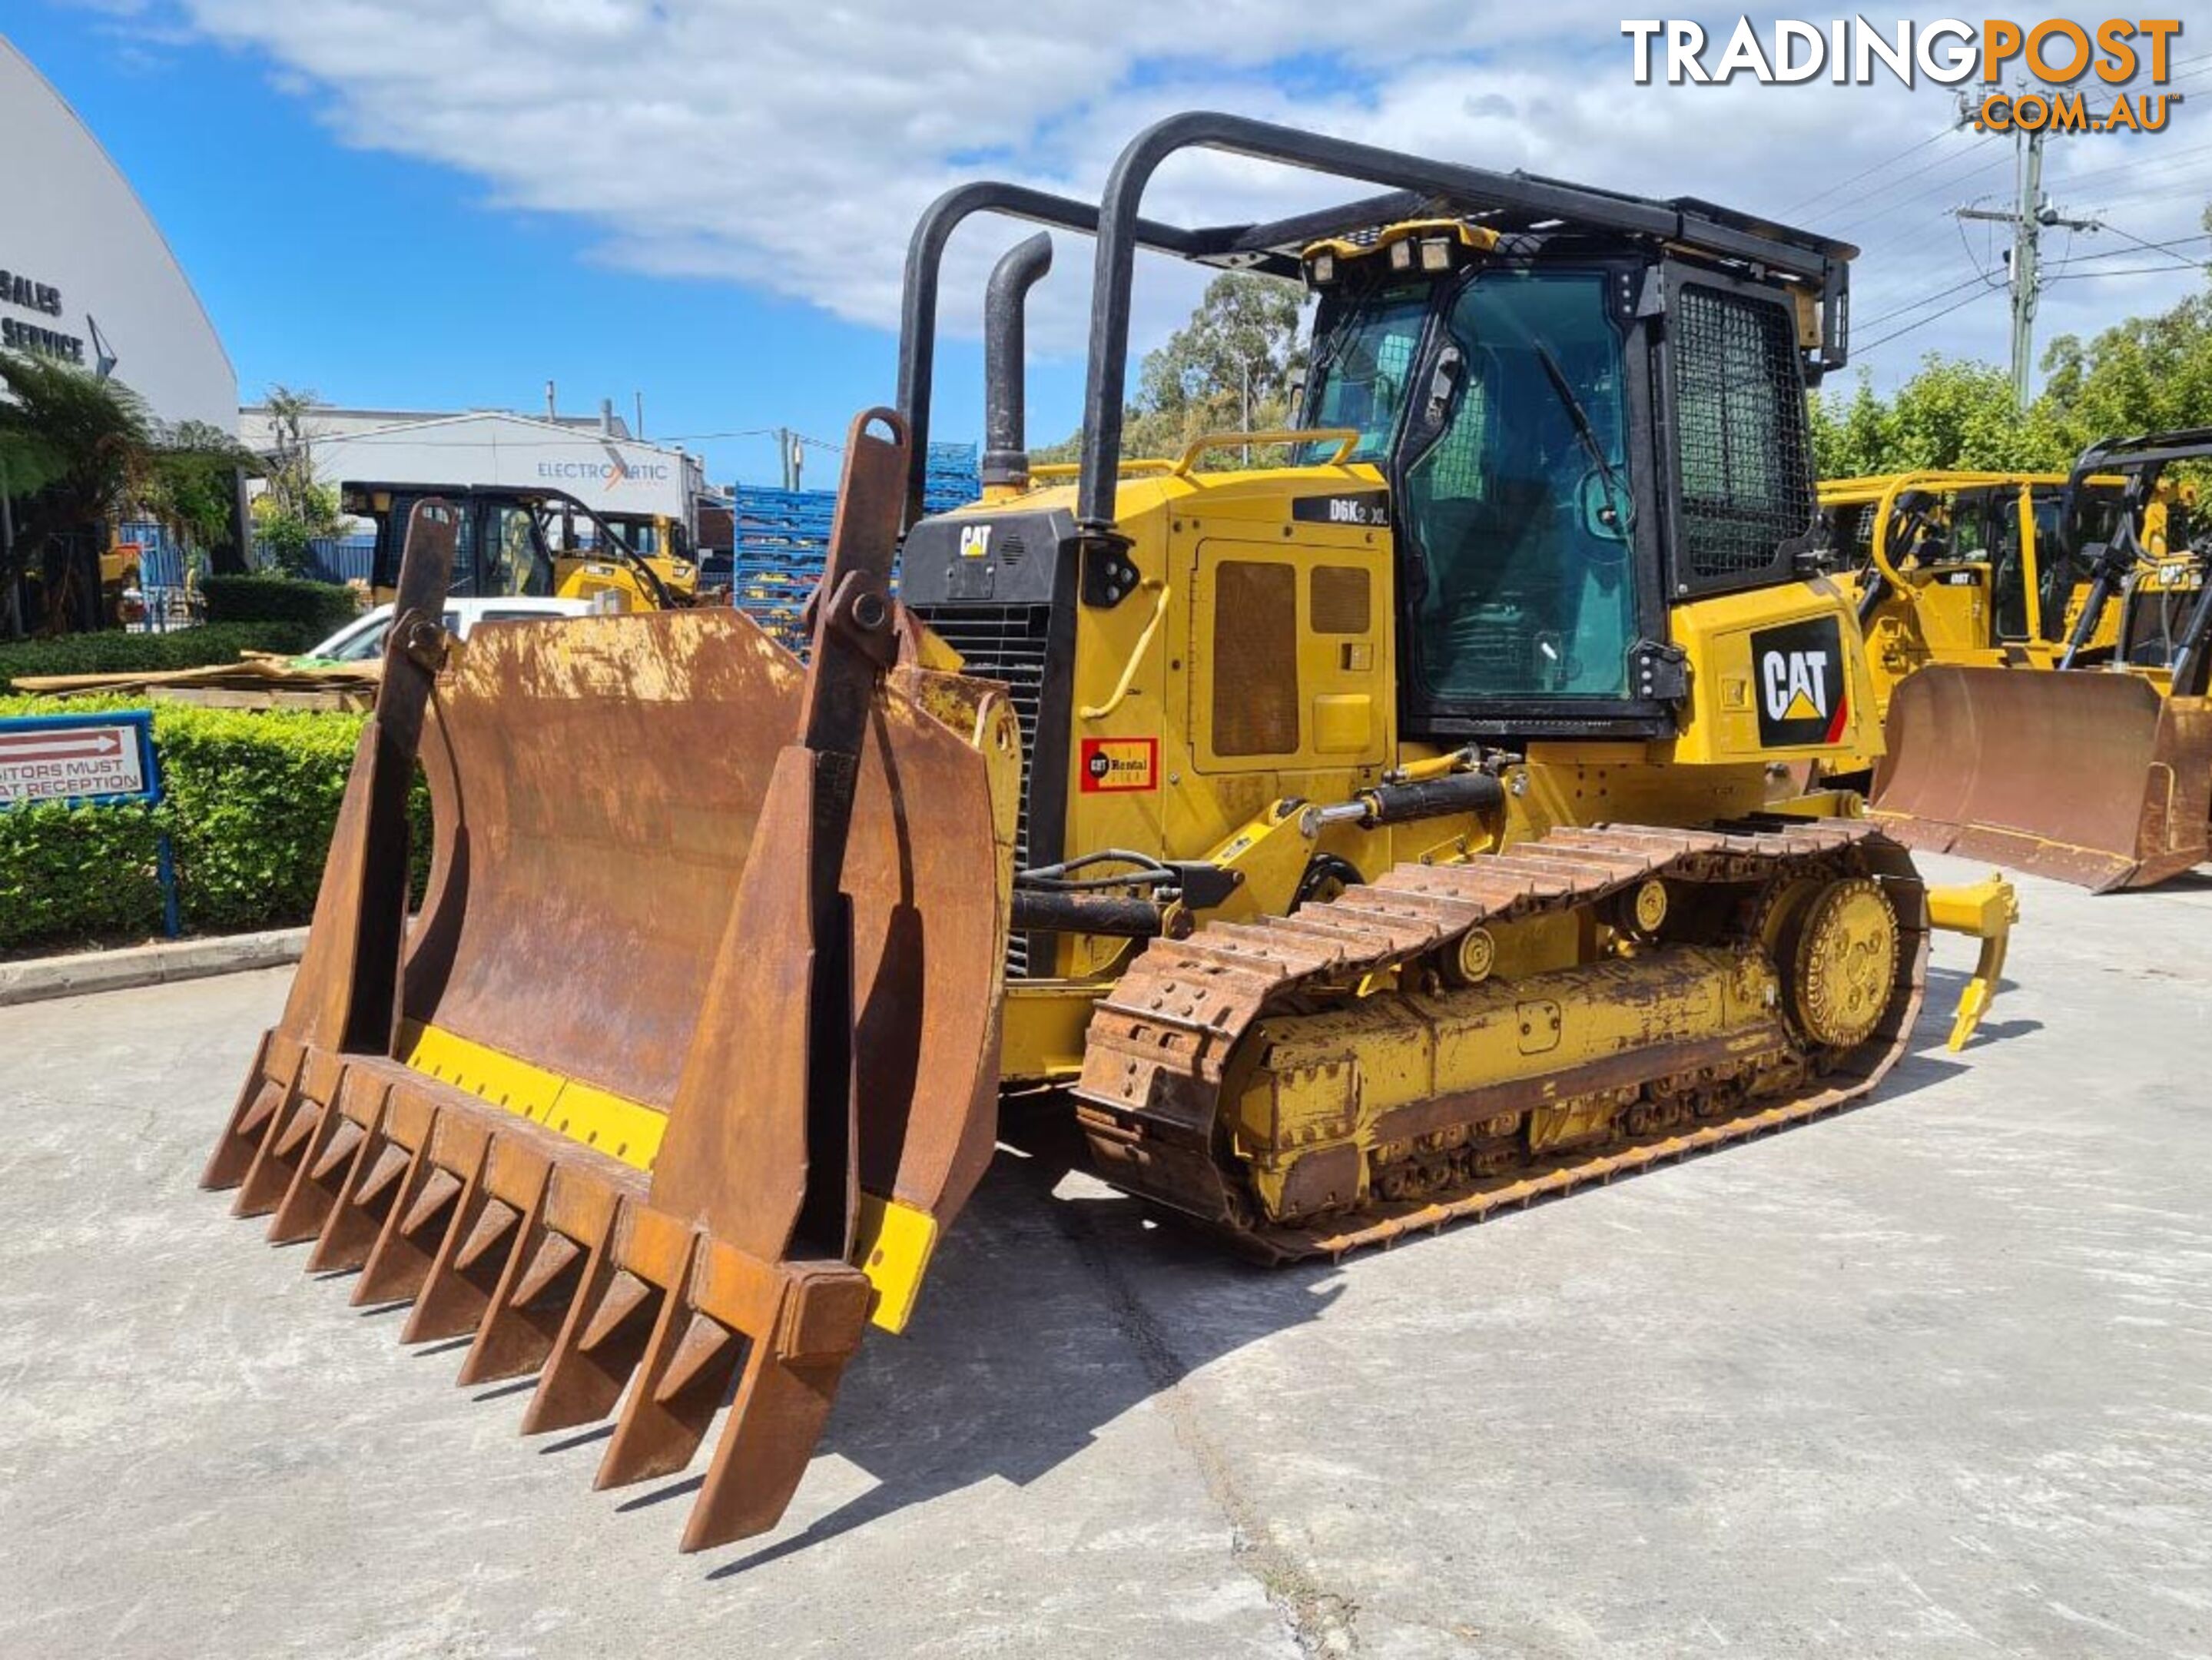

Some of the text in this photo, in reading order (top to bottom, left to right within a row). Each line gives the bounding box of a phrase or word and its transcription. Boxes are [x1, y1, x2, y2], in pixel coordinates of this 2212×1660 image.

[0, 270, 62, 317] SALES
[2, 317, 85, 367] SERVICE
[960, 525, 991, 556] CAT
[1763, 650, 1828, 721] CAT
[0, 759, 123, 780] ITORS MUST
[1111, 759, 1147, 771] Rental
[27, 775, 138, 797] RECEPTION
